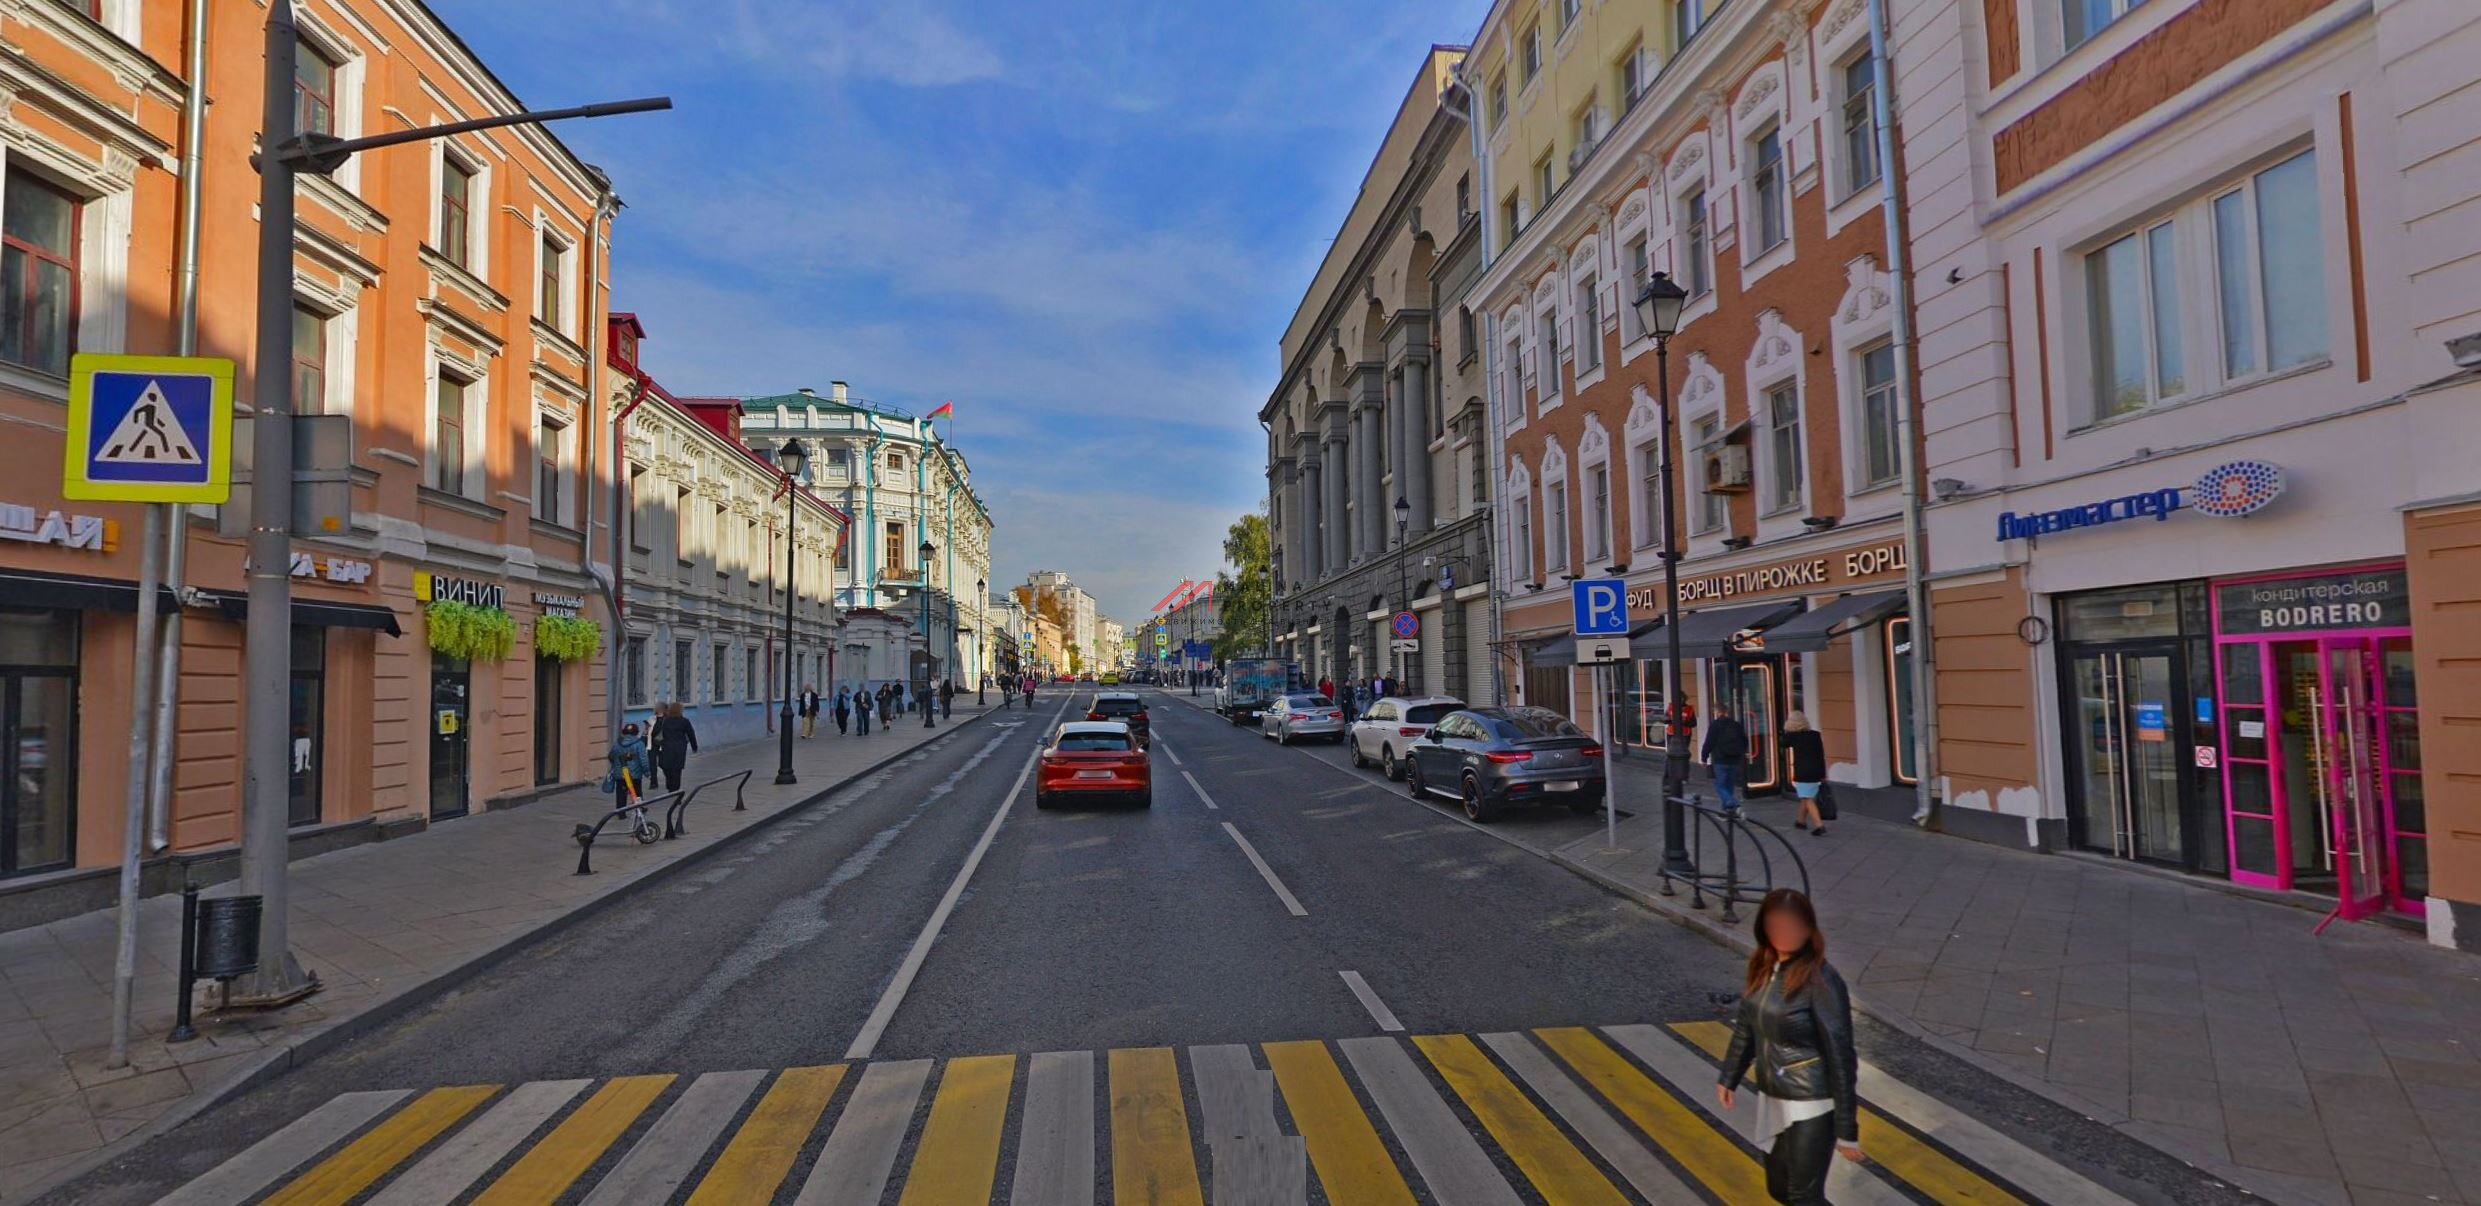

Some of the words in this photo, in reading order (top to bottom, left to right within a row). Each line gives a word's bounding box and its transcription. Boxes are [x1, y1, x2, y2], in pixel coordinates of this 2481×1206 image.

[1996, 487, 2181, 541] Линзмастер
[435, 575, 506, 609] ВИНИЛ
[1678, 577, 1722, 602] БОРЩ
[1723, 575, 1734, 596] В
[1736, 559, 1826, 592] ПИРОЖКЕ
[2251, 579, 2390, 603] кондитерская
[535, 591, 585, 609] МУЗЫКАЛЬНЫЙ
[545, 605, 577, 619] МАГАЗИН
[1587, 585, 1617, 628] P
[2260, 601, 2382, 628] BODRERO
